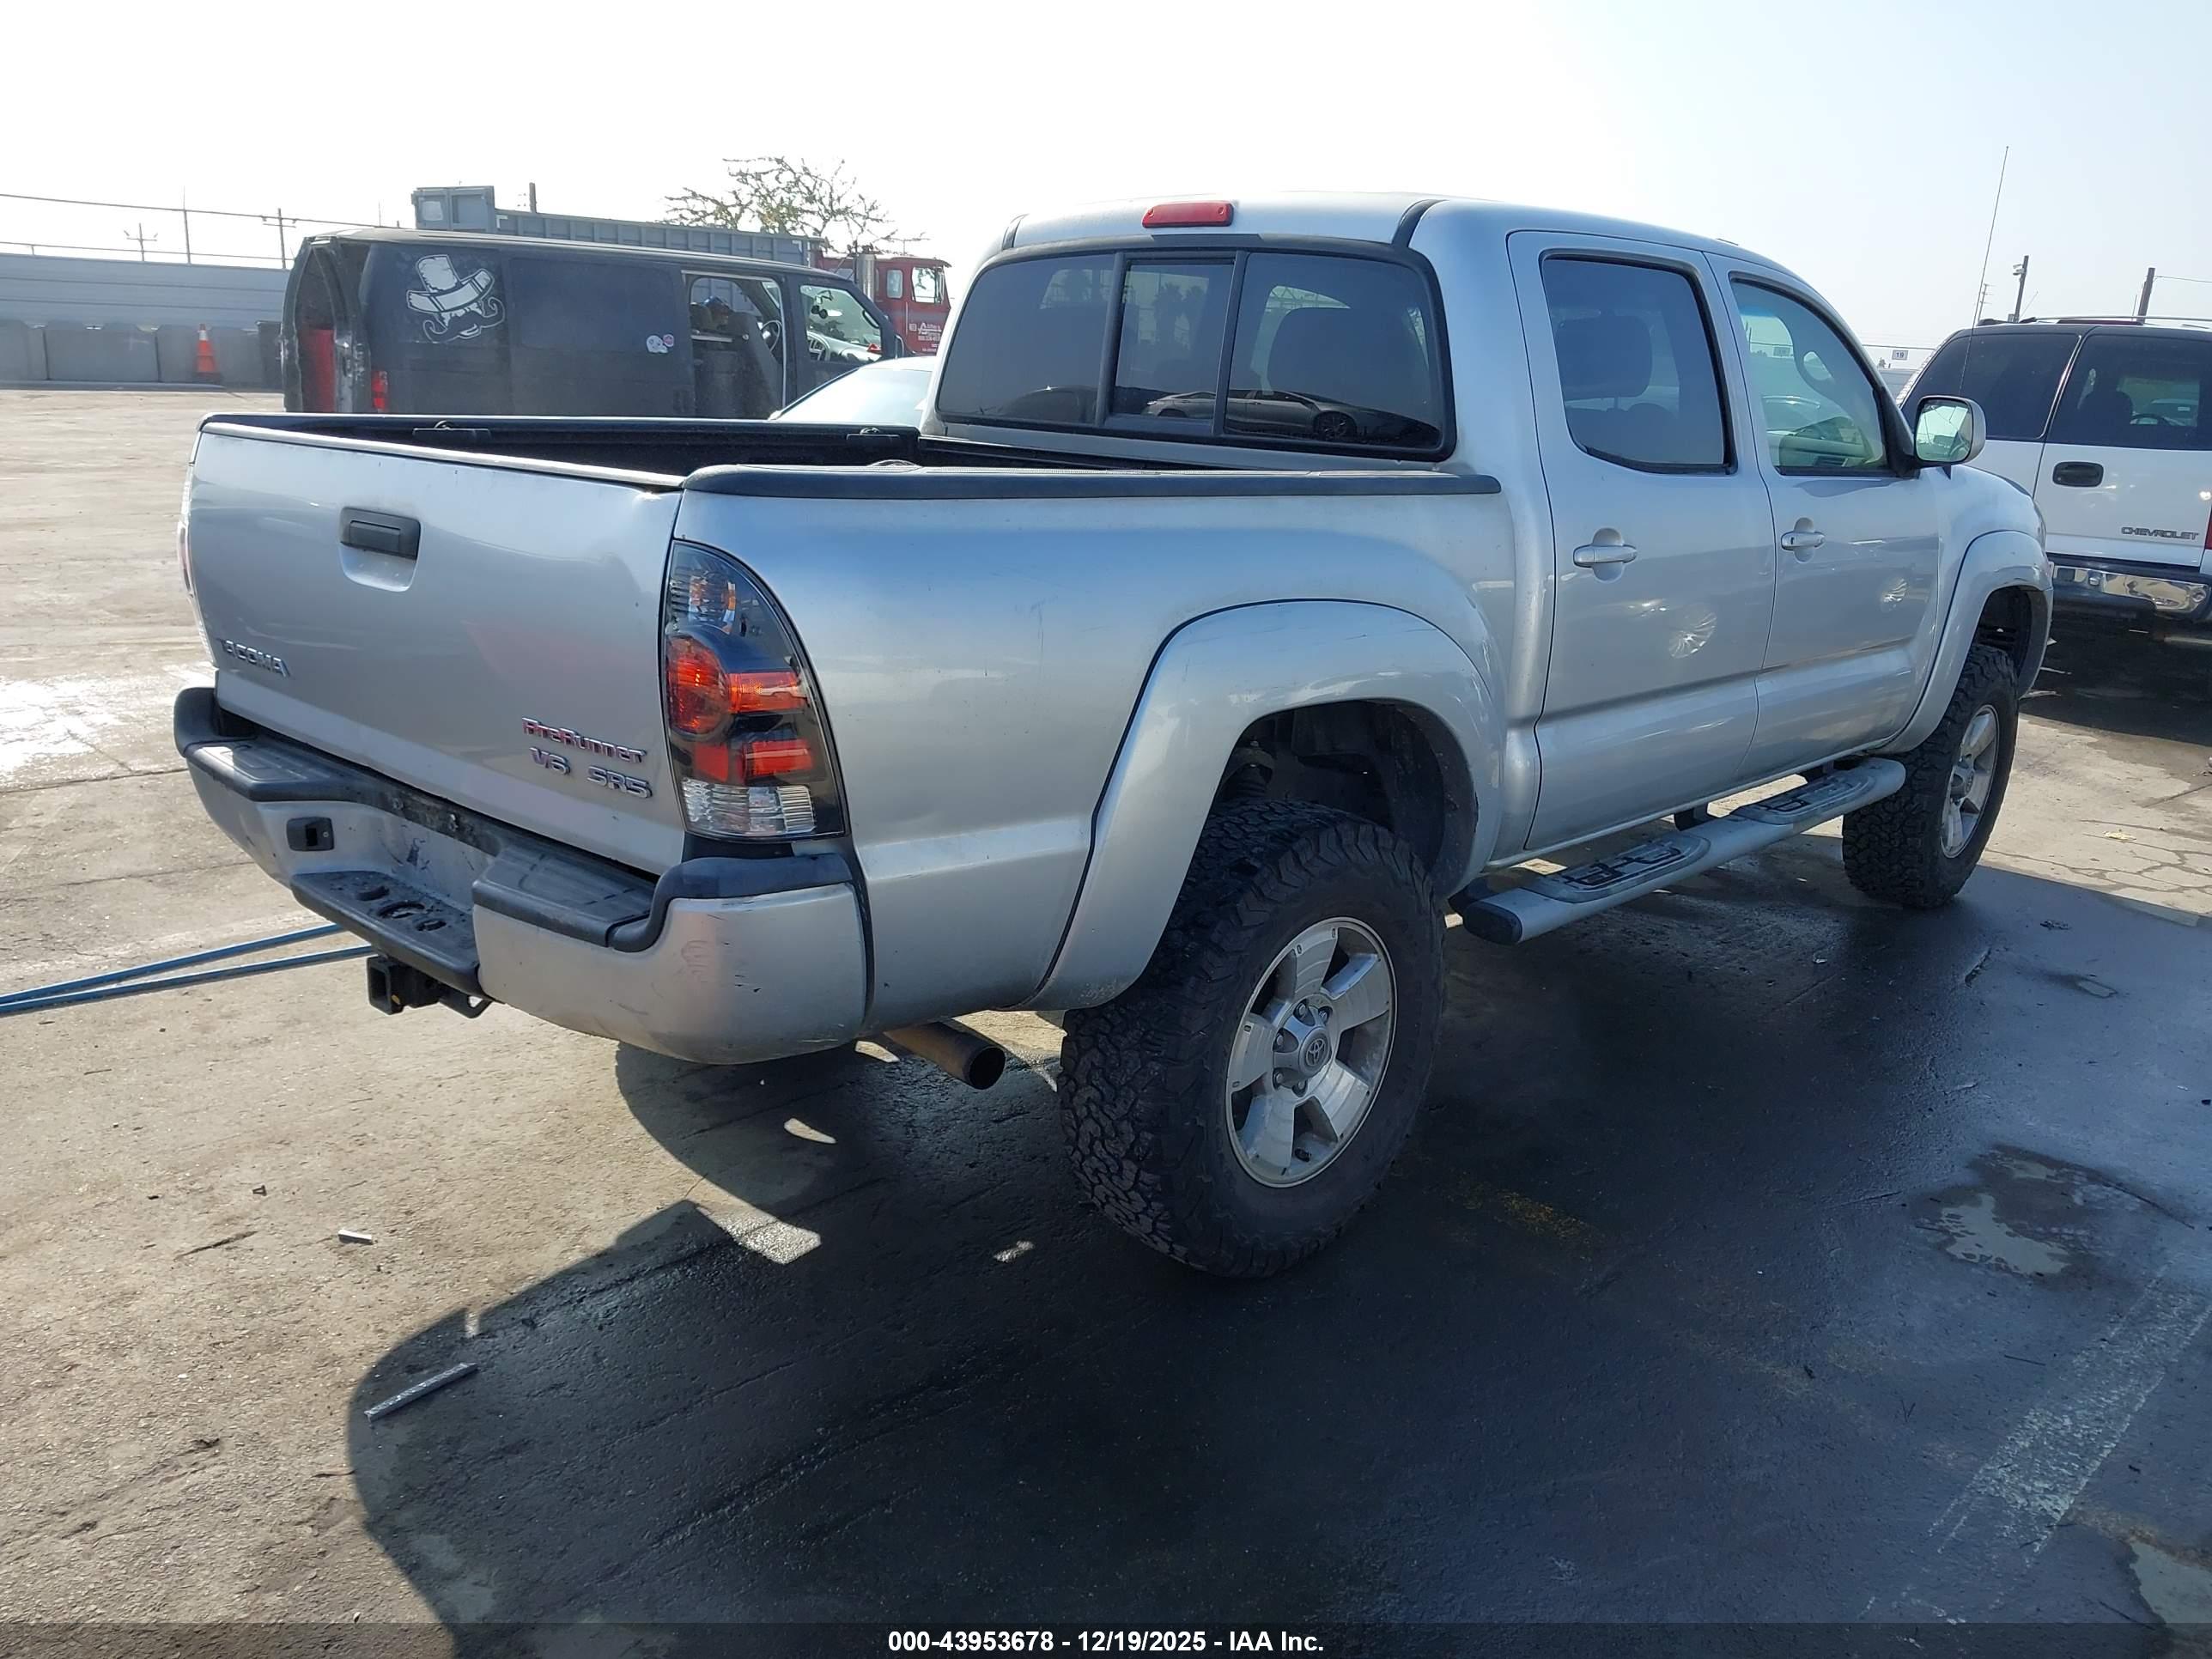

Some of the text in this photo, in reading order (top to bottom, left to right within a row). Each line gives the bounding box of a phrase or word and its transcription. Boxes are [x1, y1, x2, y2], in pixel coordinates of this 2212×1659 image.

[2121, 526, 2199, 540] CHEVROLET
[521, 716, 647, 763] PreRunner
[529, 746, 653, 799] V6 SR5
